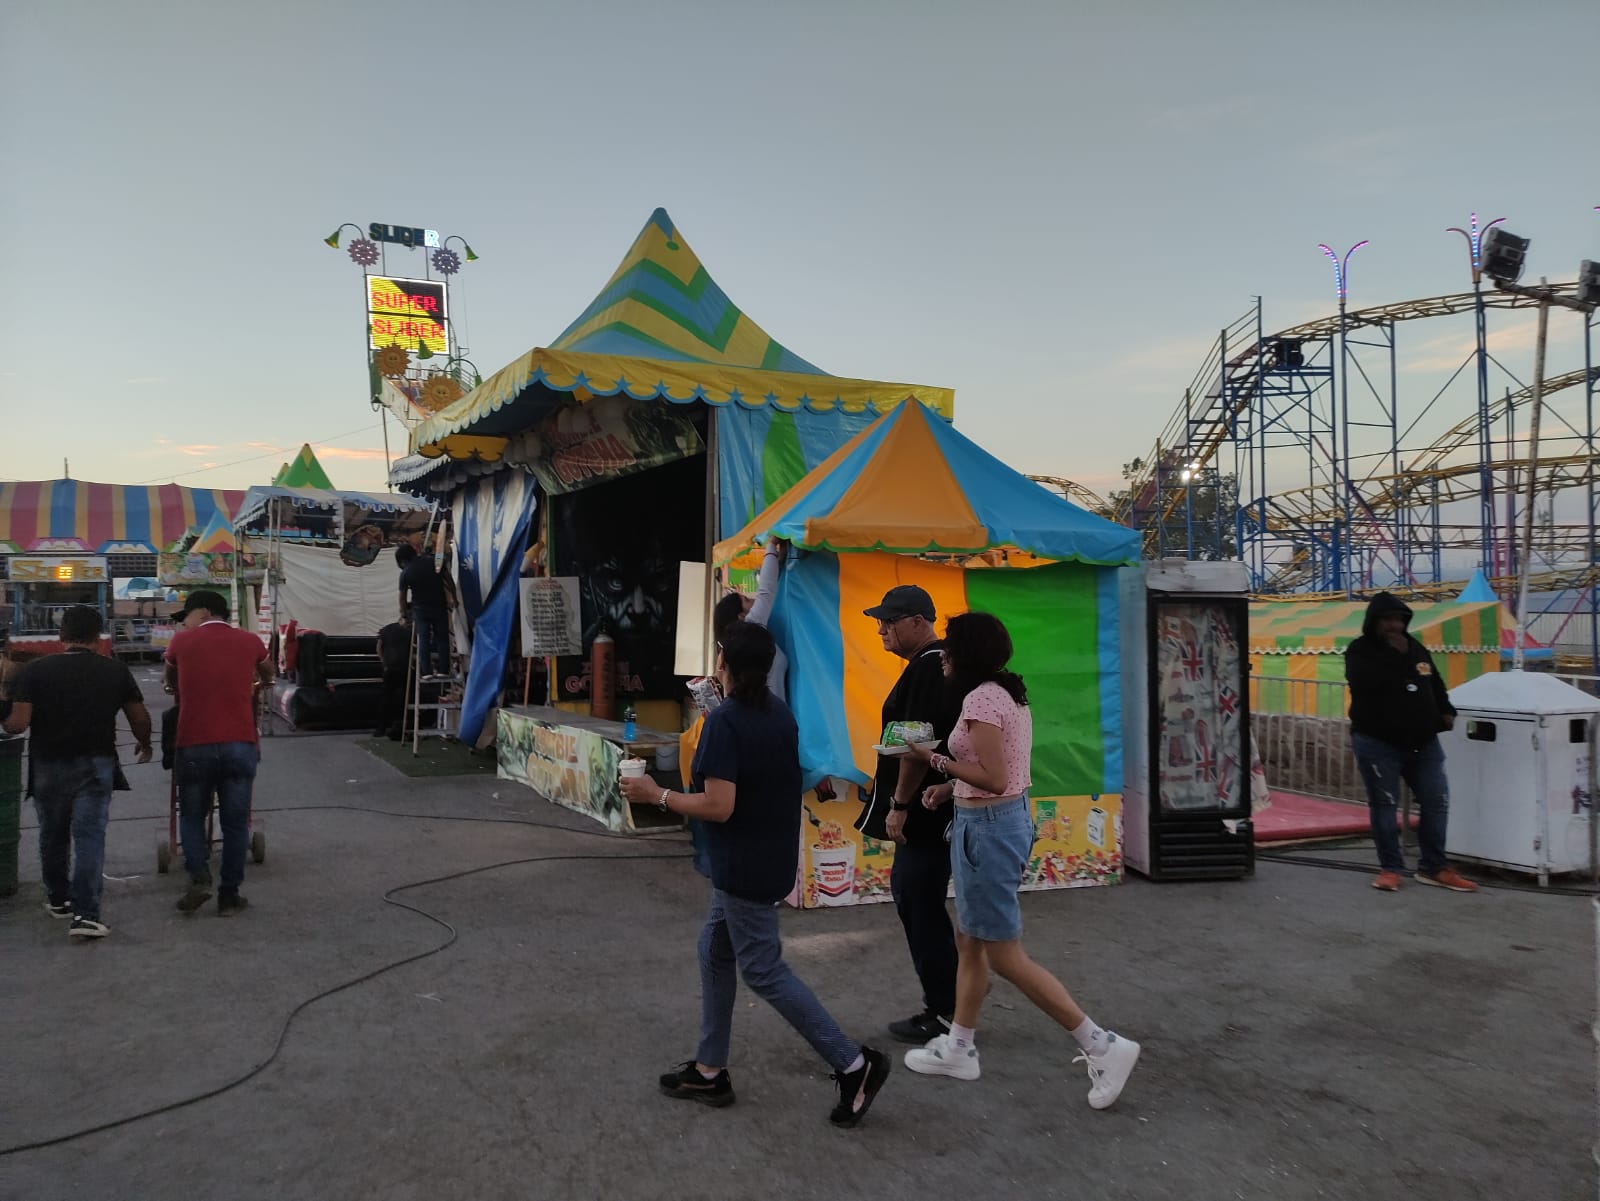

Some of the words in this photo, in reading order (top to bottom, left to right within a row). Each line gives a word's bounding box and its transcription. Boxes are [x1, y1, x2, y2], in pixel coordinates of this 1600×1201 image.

[369, 222, 440, 248] SLIDER
[371, 291, 439, 312] SUPER
[373, 319, 446, 339] SLIDER
[565, 674, 645, 693] GOHA
